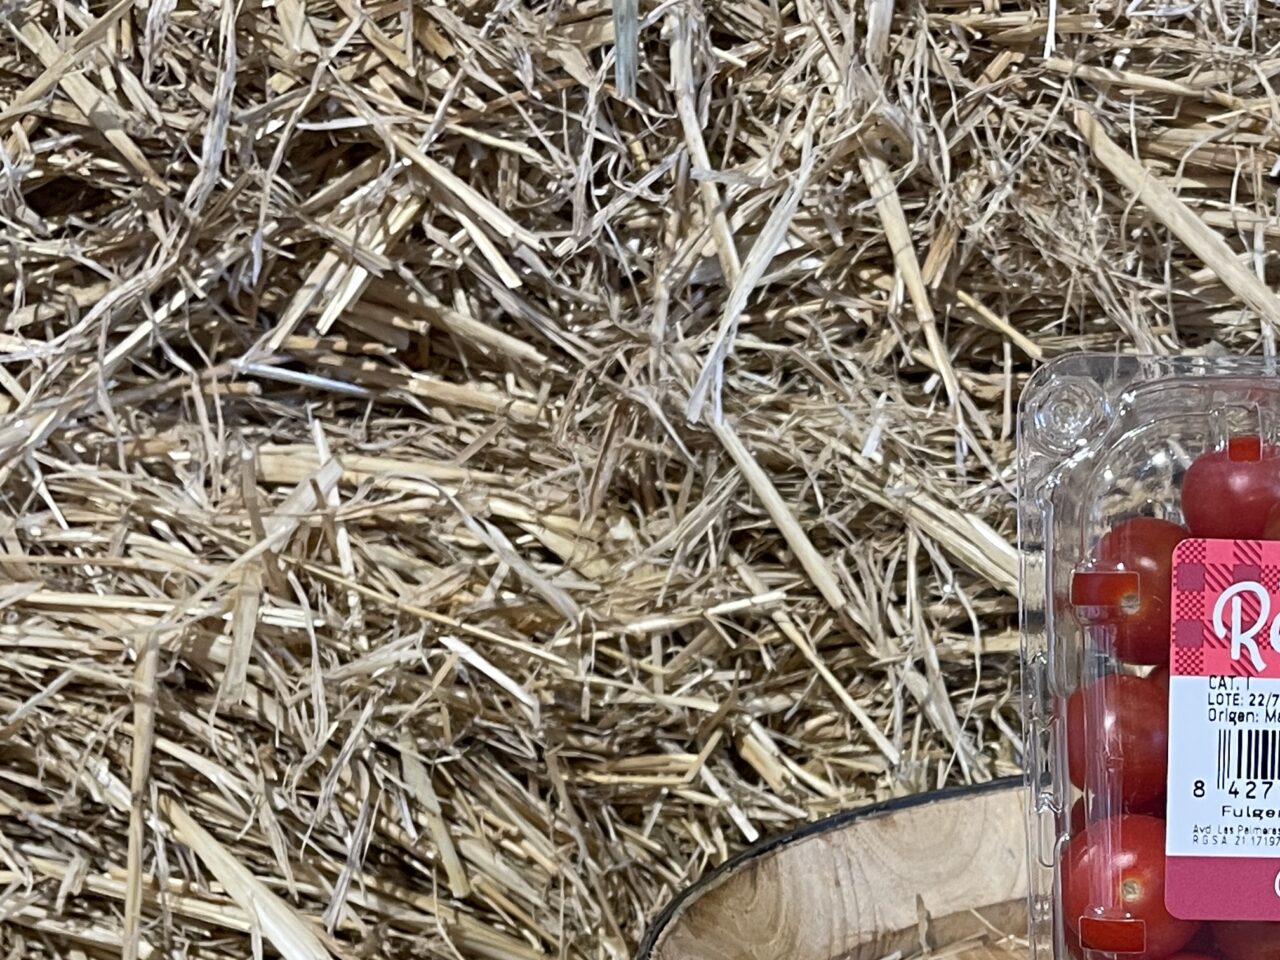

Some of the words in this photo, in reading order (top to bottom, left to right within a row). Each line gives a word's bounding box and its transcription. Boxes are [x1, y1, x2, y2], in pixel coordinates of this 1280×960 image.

[1208, 674, 1240, 691] CAT.
[1208, 692, 1244, 707] LOTE:
[1208, 707, 1260, 726] Origen:
[1193, 779, 1206, 798] 8
